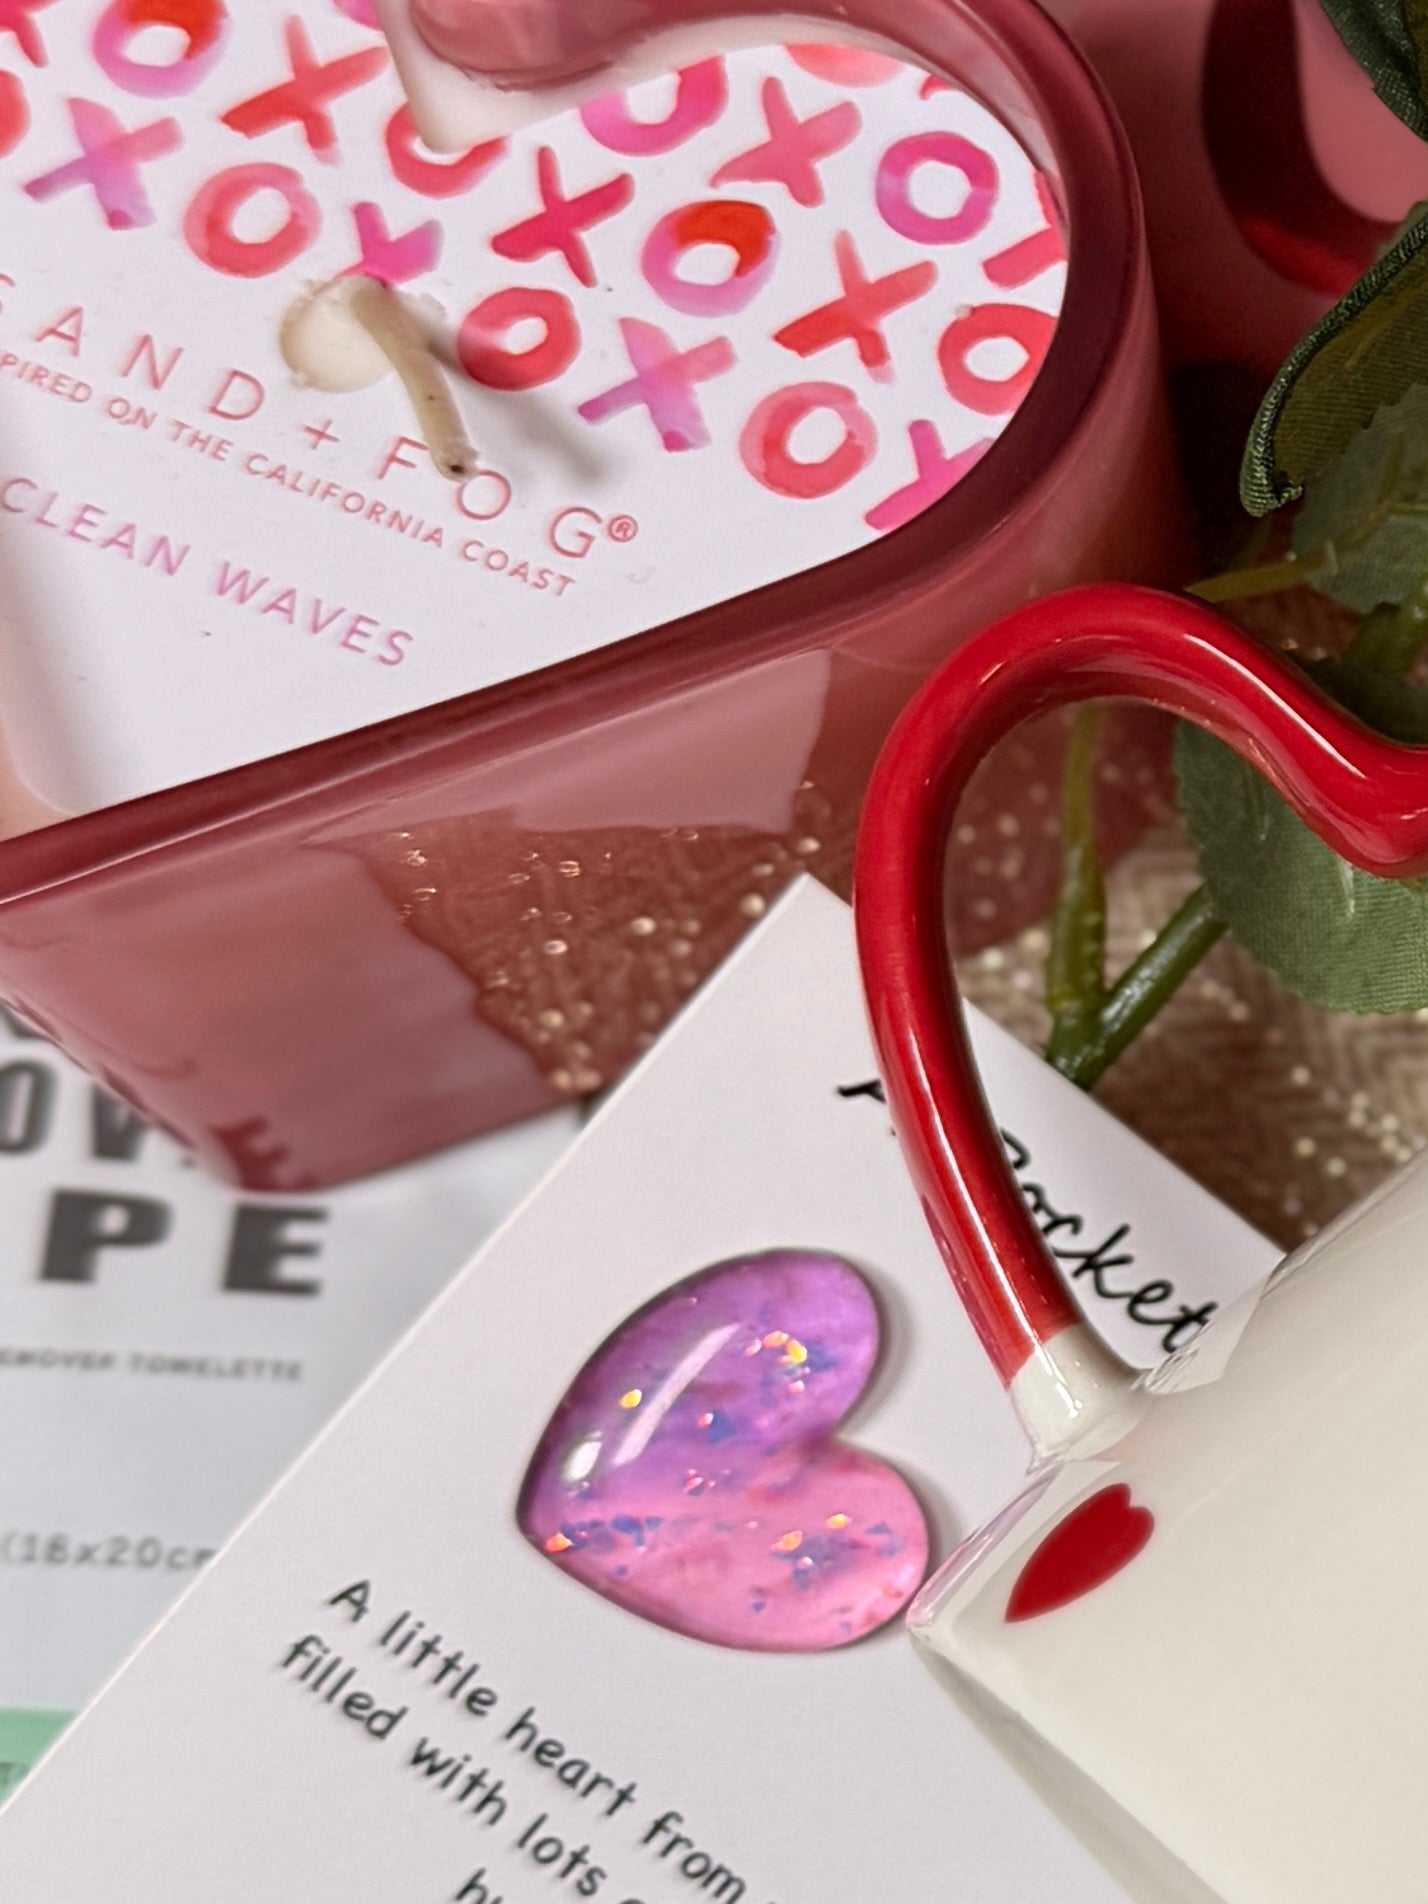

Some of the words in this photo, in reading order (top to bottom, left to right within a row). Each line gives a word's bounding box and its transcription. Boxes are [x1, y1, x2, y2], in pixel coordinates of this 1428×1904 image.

[0, 477, 192, 578] CLEAN
[212, 561, 415, 667] WAVES
[103, 396, 159, 431] ON
[168, 419, 235, 462] THE
[242, 451, 445, 549] CALIFORNIA
[458, 538, 577, 597] COAST
[278, 1633, 410, 1742] filled
[406, 1737, 508, 1827] with
[513, 1813, 608, 1899] lots
[325, 1578, 371, 1624] A
[376, 1609, 499, 1718] little
[501, 1706, 638, 1817] heart
